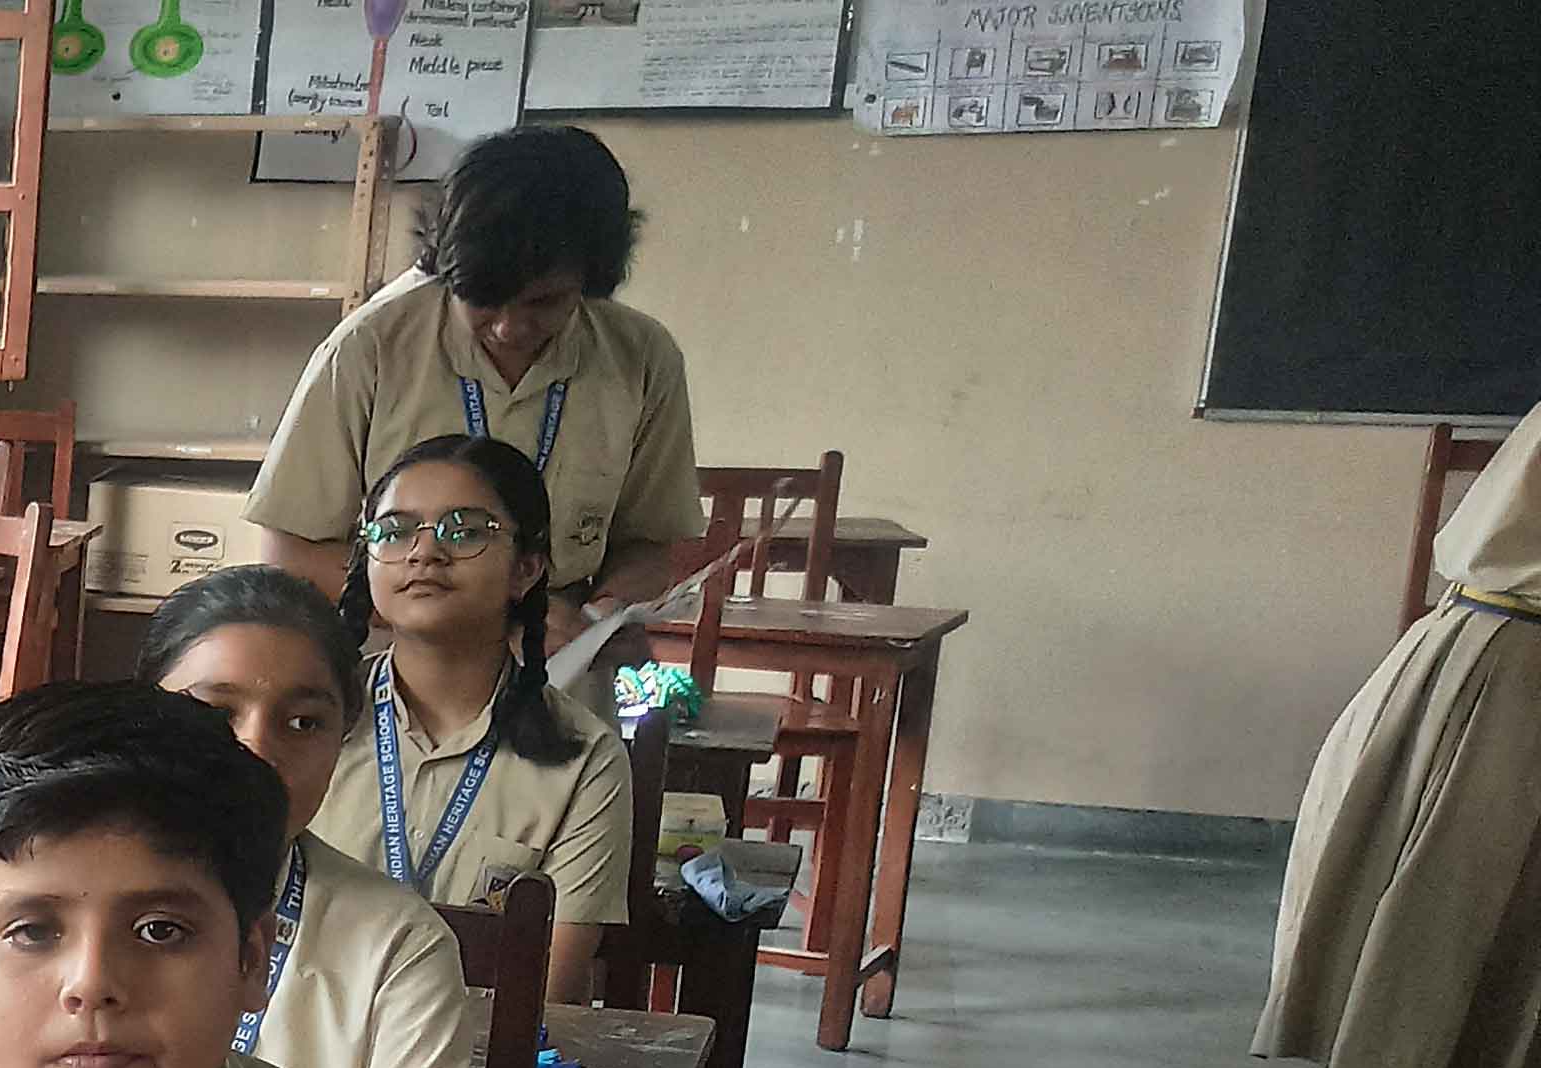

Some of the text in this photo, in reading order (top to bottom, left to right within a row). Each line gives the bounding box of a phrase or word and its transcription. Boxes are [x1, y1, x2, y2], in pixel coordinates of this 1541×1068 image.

[965, 4, 1038, 32] MAJOR
[409, 32, 443, 48] Neck
[408, 55, 460, 75] Middle
[378, 706, 395, 763] SCHOOL
[381, 765, 400, 834] HERITAGE
[442, 768, 483, 835] HERITAGE
